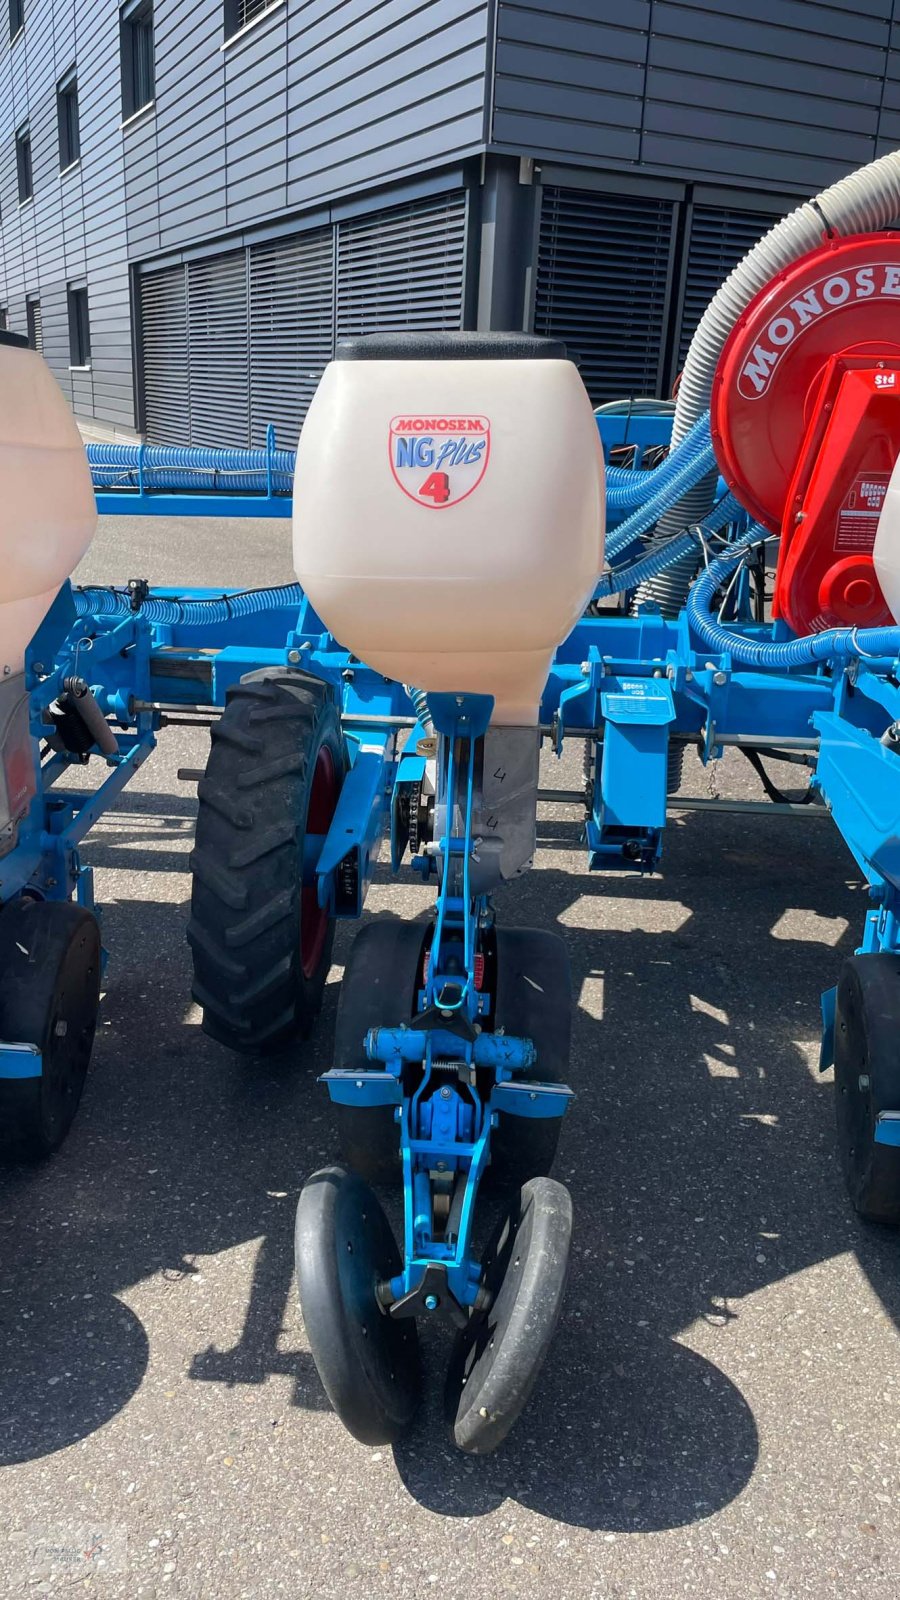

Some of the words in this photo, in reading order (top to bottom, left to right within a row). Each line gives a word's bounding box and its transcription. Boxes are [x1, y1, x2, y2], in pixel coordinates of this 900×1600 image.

[874, 373, 895, 385] Std
[395, 419, 485, 431] MONOSEM
[396, 437, 434, 468] NG
[418, 472, 450, 503] 4
[493, 767, 507, 783] 4
[486, 815, 499, 831] 4
